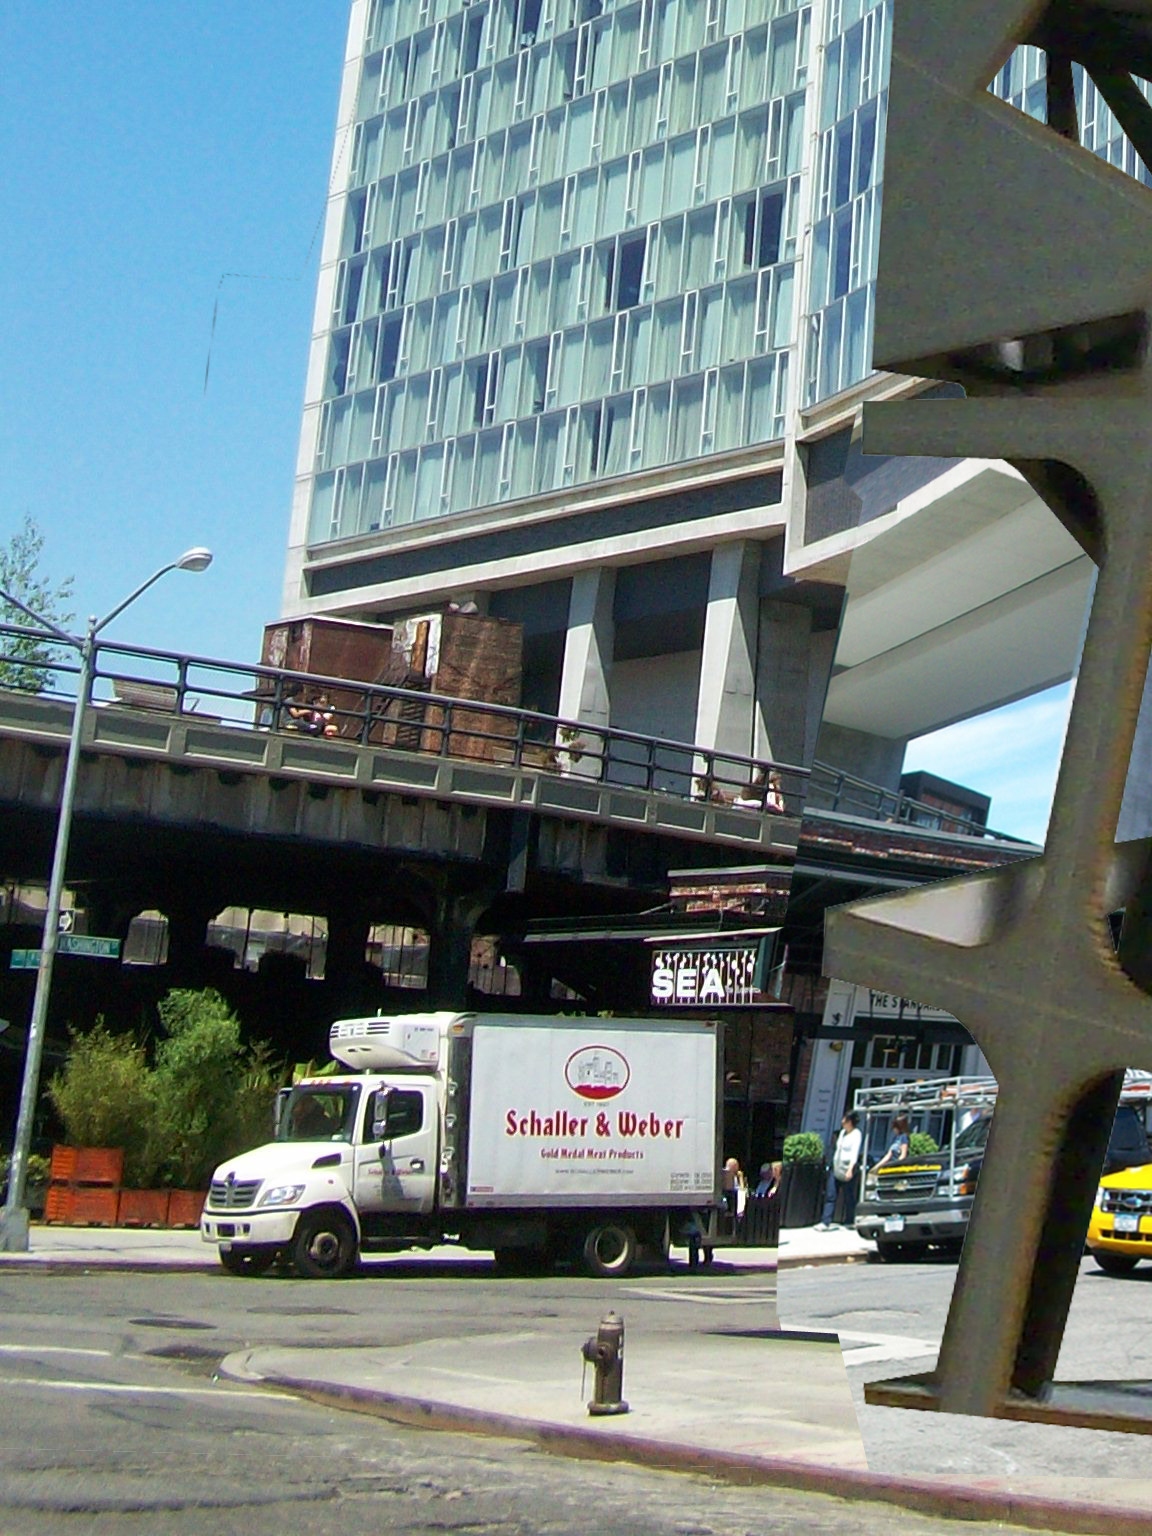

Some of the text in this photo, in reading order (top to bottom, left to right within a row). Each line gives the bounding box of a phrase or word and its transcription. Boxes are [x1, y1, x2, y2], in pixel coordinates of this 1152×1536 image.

[651, 968, 726, 998] SEA
[505, 1109, 684, 1139] Schaller & Weber
[540, 1148, 644, 1160] Gold Medal Meat Products
